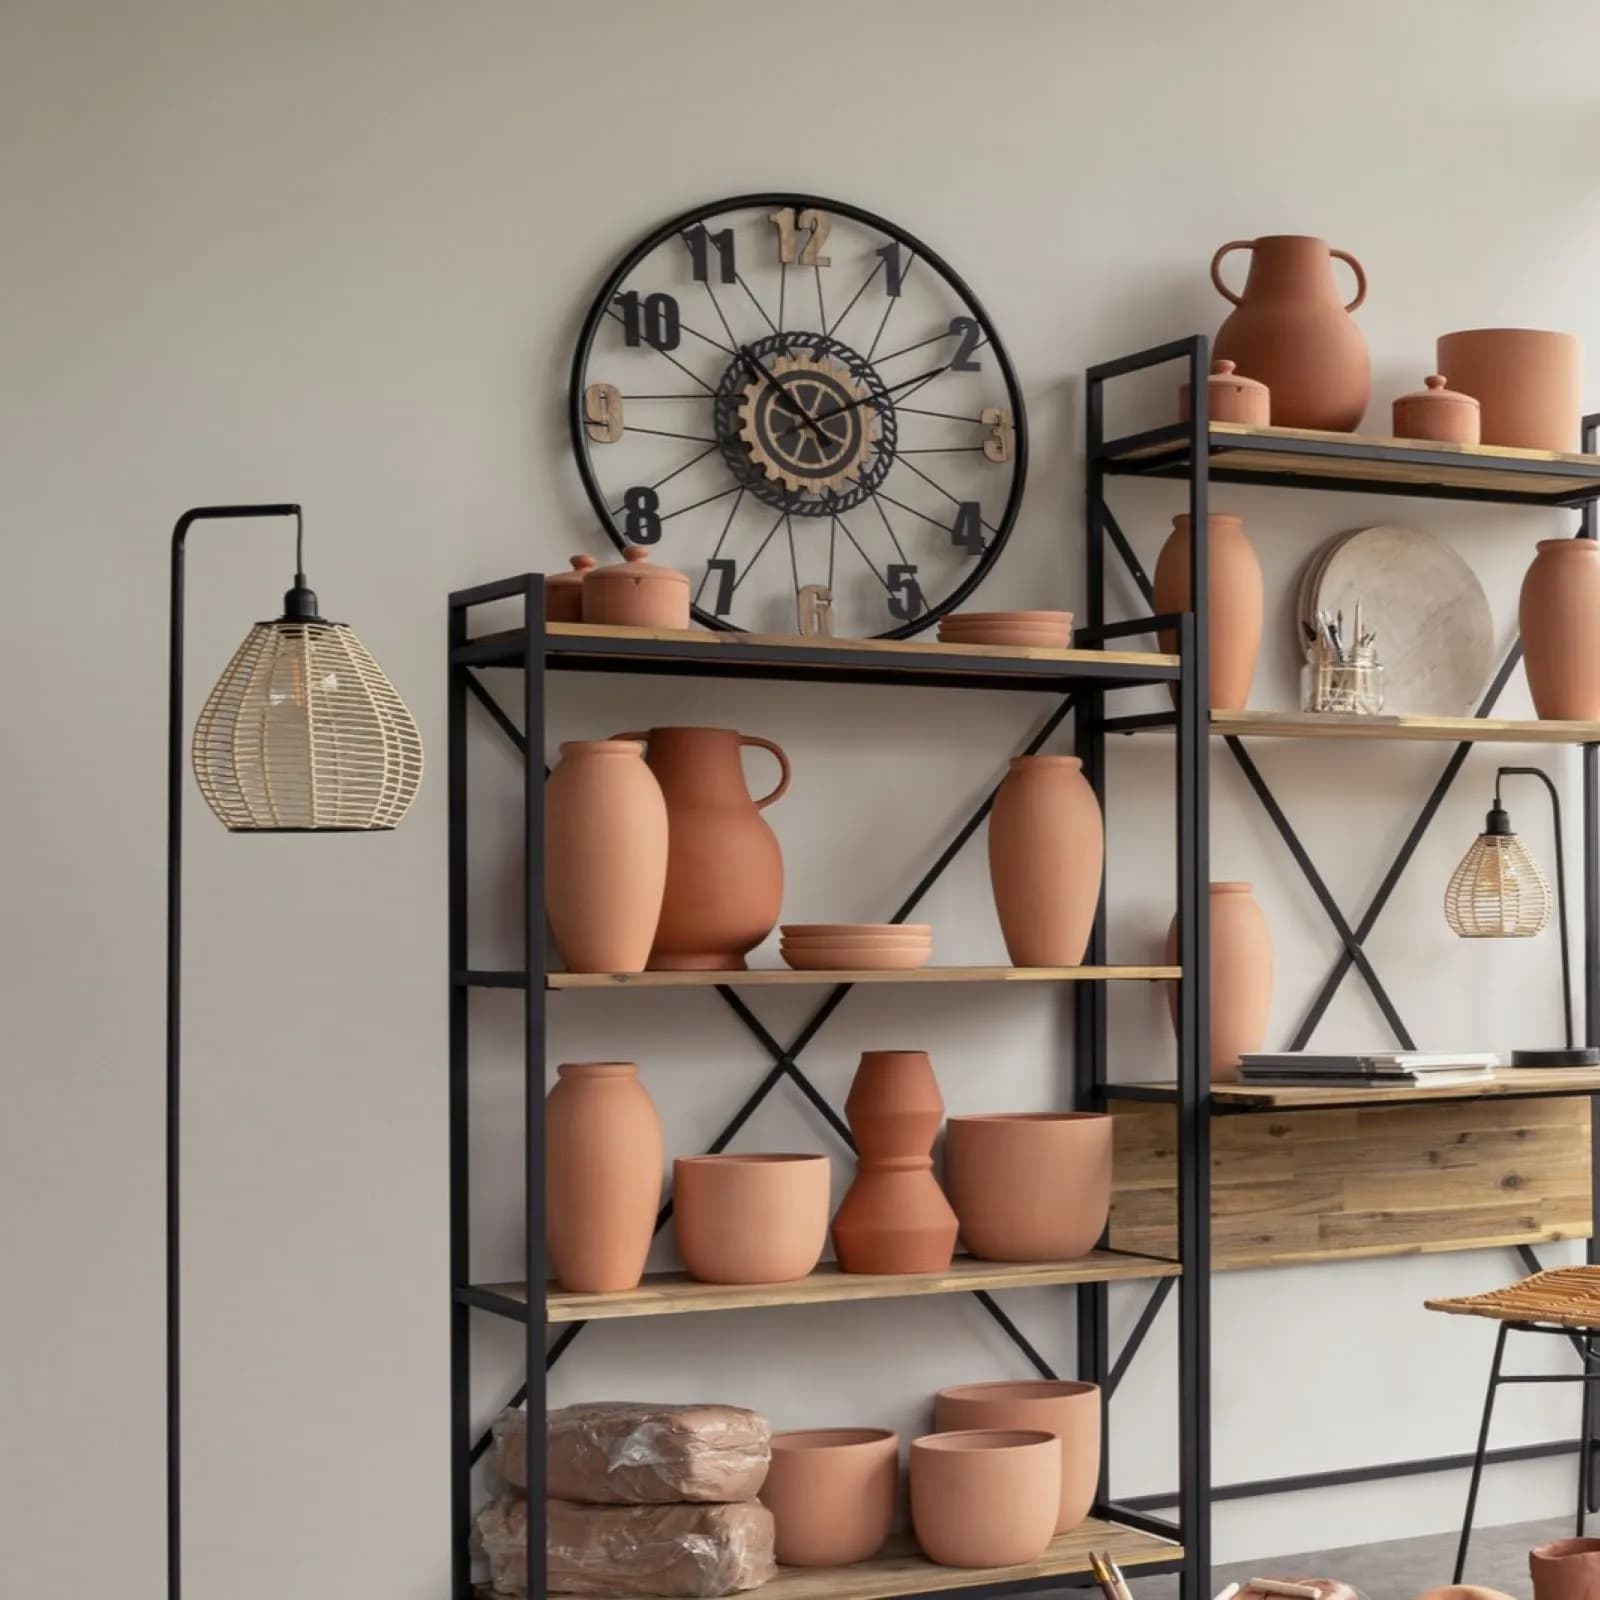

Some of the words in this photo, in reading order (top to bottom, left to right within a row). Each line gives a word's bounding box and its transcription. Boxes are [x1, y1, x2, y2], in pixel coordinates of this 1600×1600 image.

[681, 223, 736, 284] 11
[768, 207, 831, 267] 12
[876, 242, 903, 298] 1
[613, 290, 681, 351] 10
[949, 316, 981, 372] 2
[584, 383, 623, 444] 9
[980, 407, 1016, 464] 3
[623, 486, 662, 545] 8
[950, 501, 986, 556] 4
[707, 558, 736, 616] 7
[798, 584, 833, 638] 6
[887, 564, 922, 620] 5
